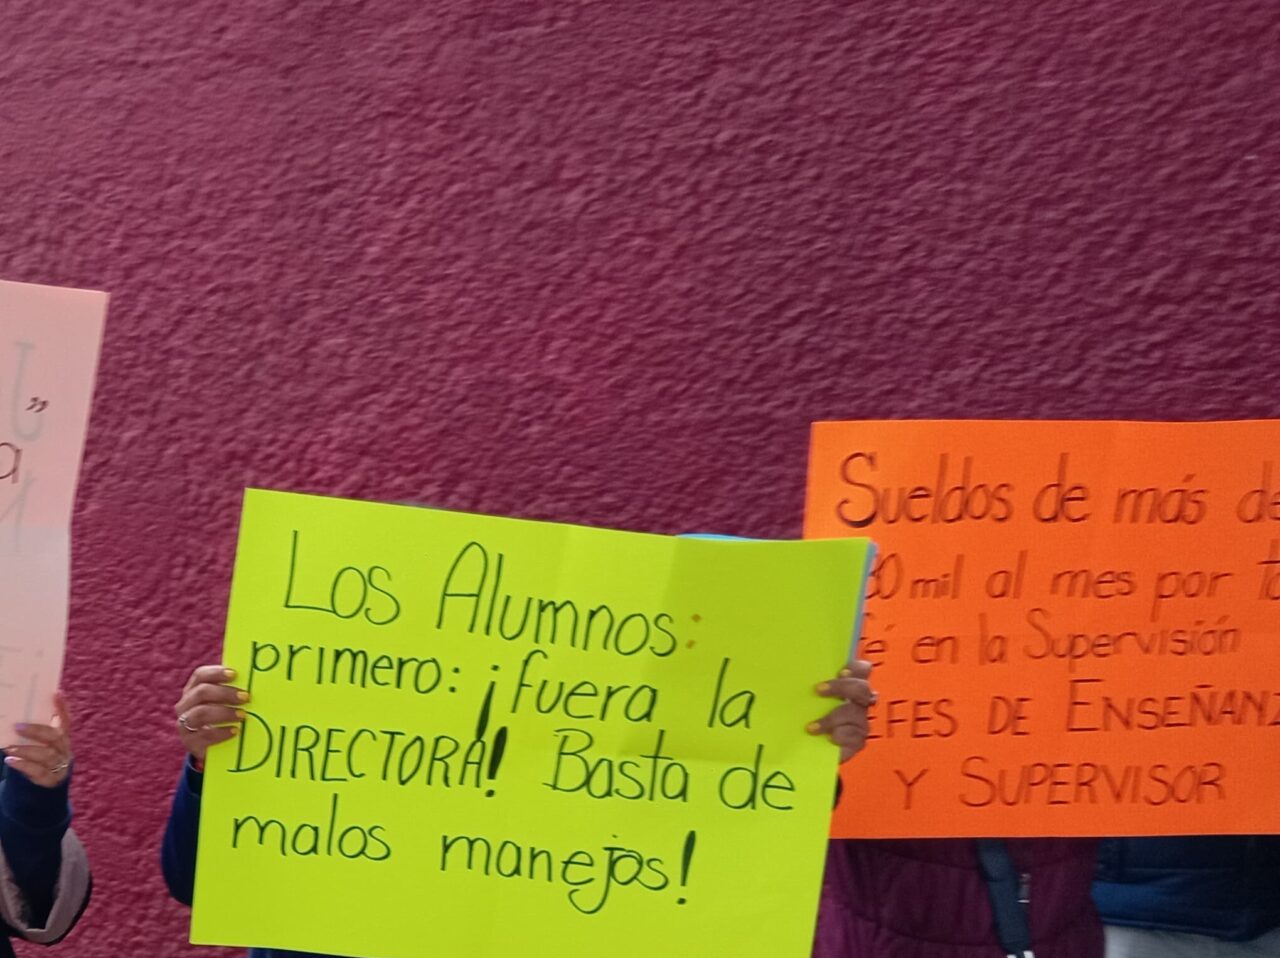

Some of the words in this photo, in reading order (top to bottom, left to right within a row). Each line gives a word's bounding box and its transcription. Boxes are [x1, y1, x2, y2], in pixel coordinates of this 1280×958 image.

[836, 452, 1014, 528] Sueldos
[1033, 452, 1093, 524] de
[1113, 473, 1208, 526] más
[910, 554, 965, 600] mil
[985, 549, 1028, 600] al
[1050, 568, 1137, 600] mes
[1149, 570, 1234, 622] por
[911, 635, 960, 665] en
[977, 612, 1009, 666] la
[1023, 608, 1242, 673] Supervisión
[247, 640, 461, 695] primero:
[707, 658, 756, 730] la
[866, 698, 960, 740] EFES
[987, 697, 1032, 737] DE
[227, 711, 509, 798] DIRECTORA!
[542, 728, 689, 802] Basta
[718, 744, 796, 812] de
[893, 767, 930, 811] Y
[958, 756, 1228, 808] SUPERVISOR
[231, 793, 392, 863] malos
[440, 830, 698, 914] manejos!
